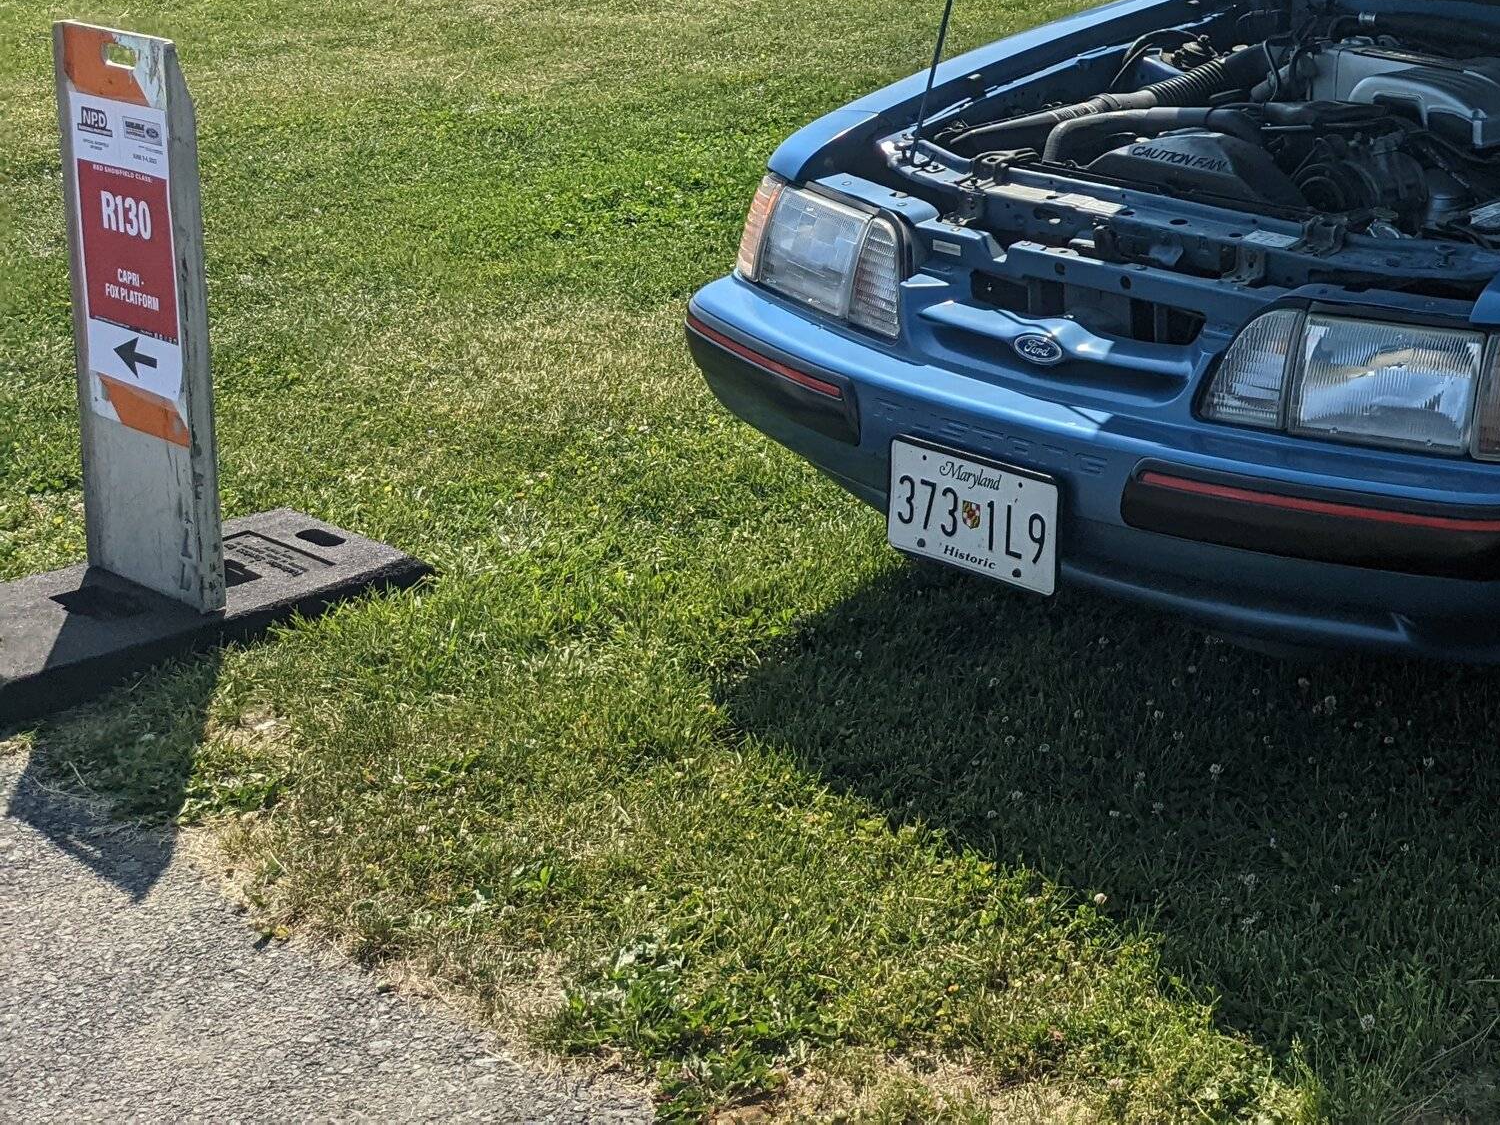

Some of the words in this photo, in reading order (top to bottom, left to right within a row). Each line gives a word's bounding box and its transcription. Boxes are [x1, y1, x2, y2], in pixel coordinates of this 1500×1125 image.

[1132, 146, 1193, 166] CAUTION
[1193, 155, 1229, 172] FAN
[100, 190, 152, 240] R130
[117, 267, 140, 287] CAPRI
[105, 283, 120, 301] FOX
[121, 288, 160, 312] PLATFORM
[938, 460, 1002, 492] Maryland
[897, 474, 959, 538] 373
[986, 500, 1046, 565] 1L9
[943, 544, 997, 570] Historic
